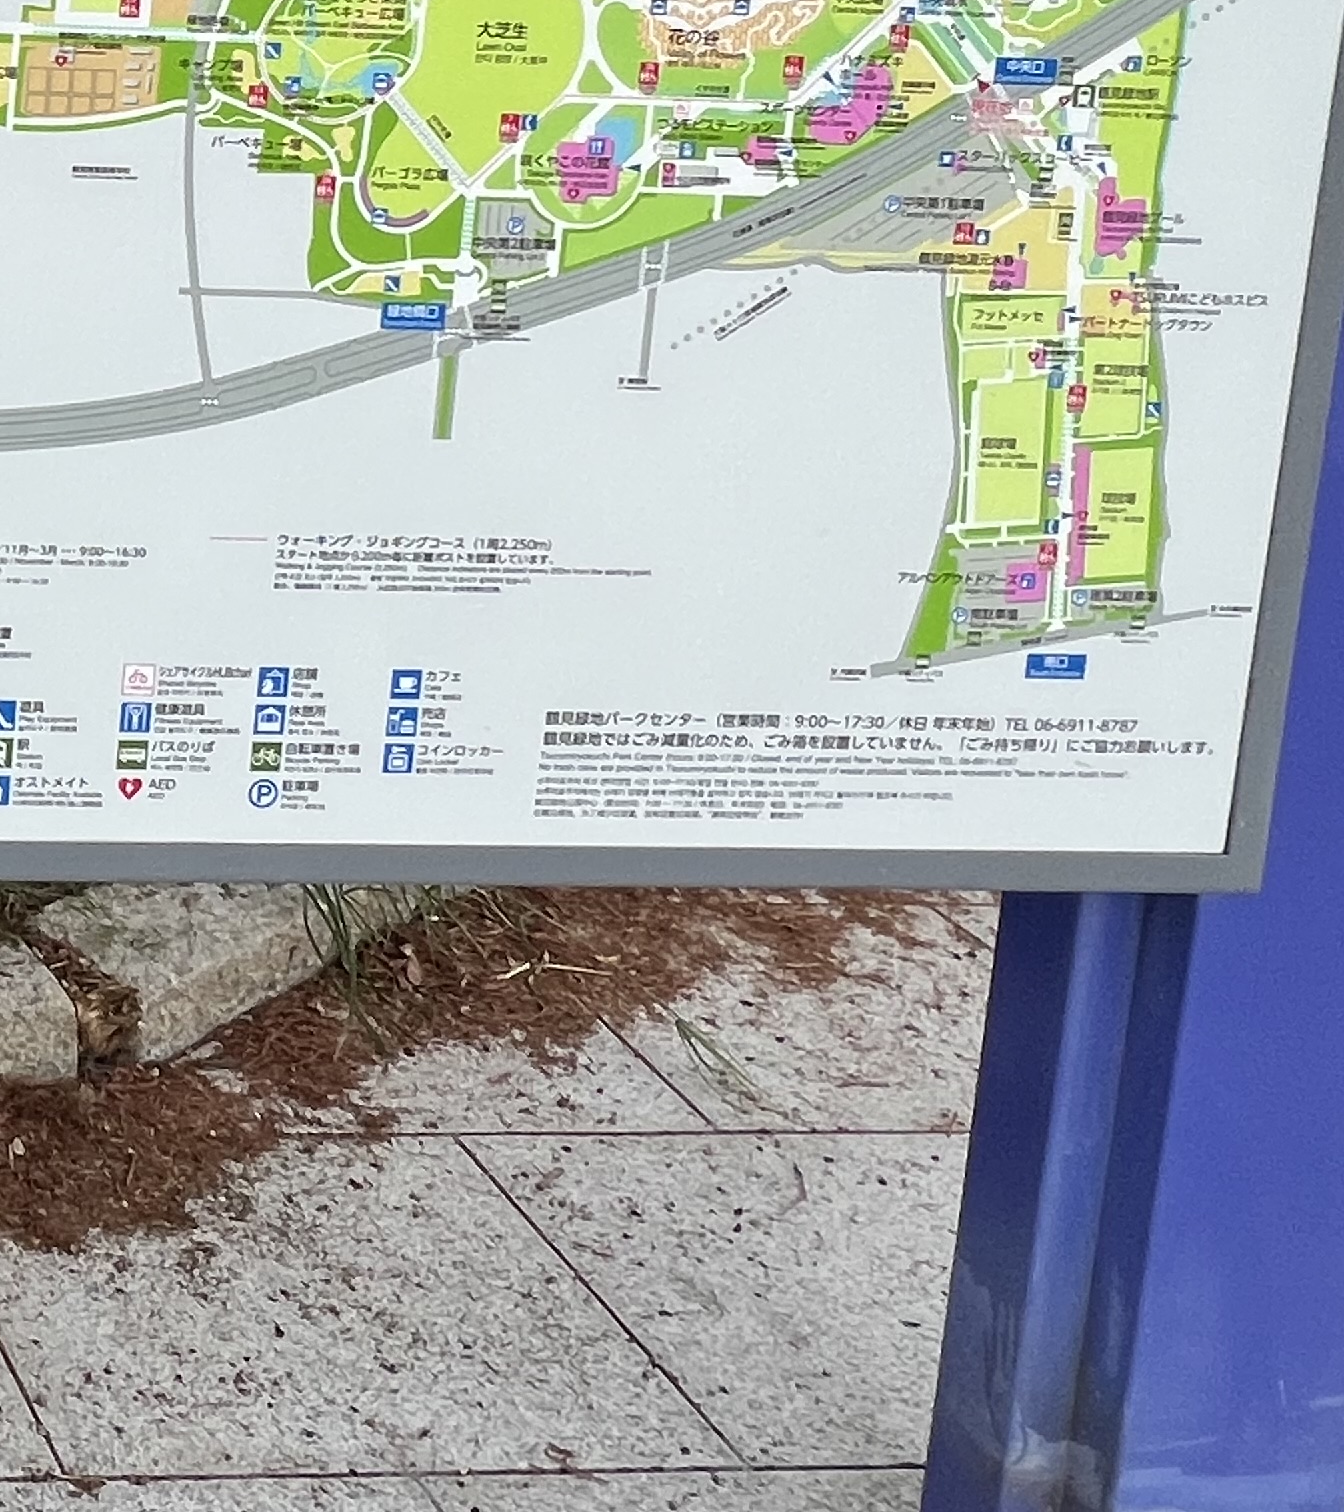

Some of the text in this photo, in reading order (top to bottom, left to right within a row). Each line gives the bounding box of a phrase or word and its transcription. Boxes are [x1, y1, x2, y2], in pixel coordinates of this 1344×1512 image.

[476, 21, 529, 39] 大芝生
[424, 670, 462, 683] カフェ
[1005, 717, 1030, 732] TEL
[147, 778, 178, 790] AED
